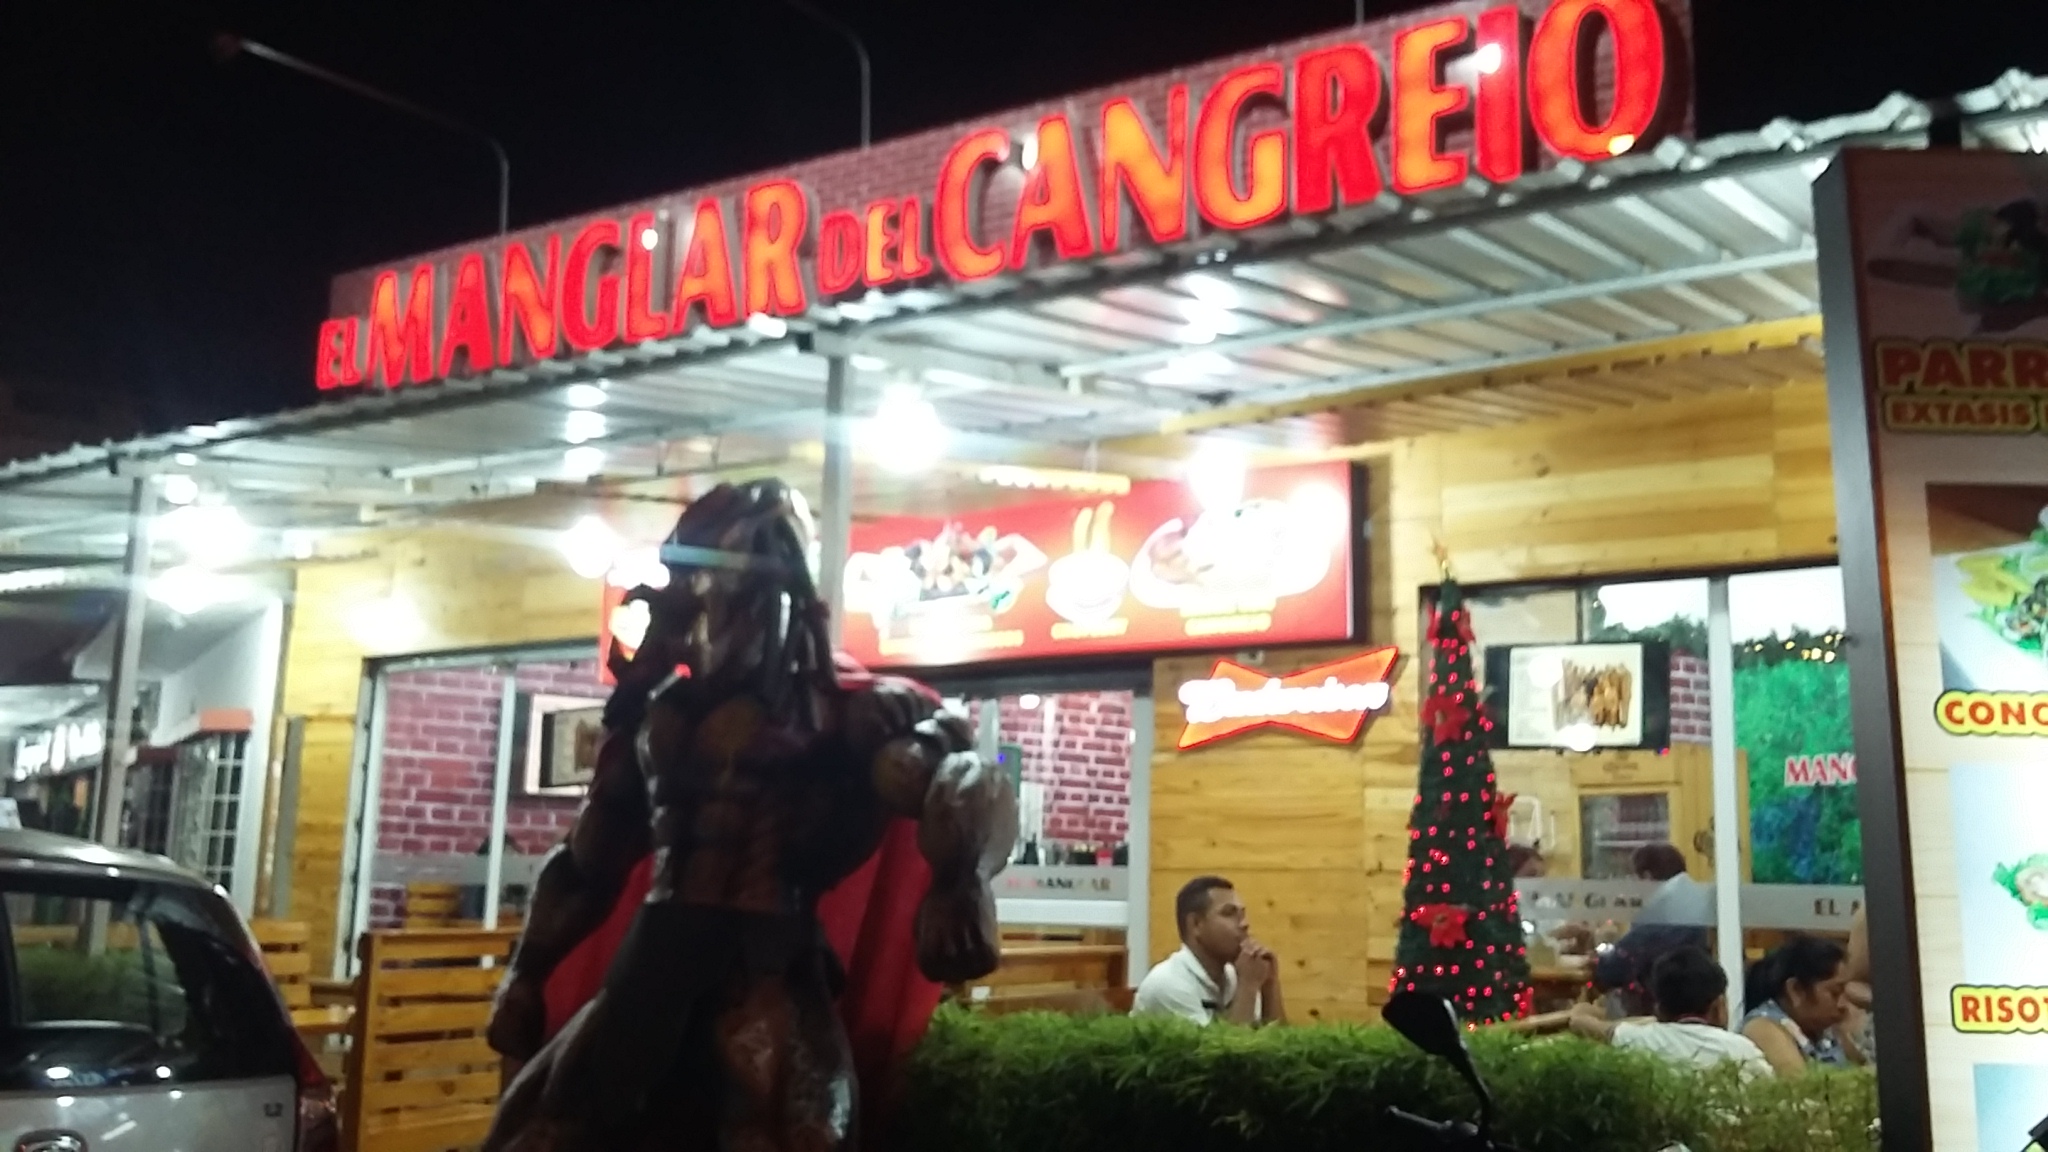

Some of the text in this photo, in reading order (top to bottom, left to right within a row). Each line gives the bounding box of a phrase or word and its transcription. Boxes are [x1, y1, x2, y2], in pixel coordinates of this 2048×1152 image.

[316, 317, 363, 390] EL
[367, 178, 807, 388] MANGLAR
[817, 195, 932, 294] DEL
[1890, 401, 2032, 426] EXTASIS
[1786, 754, 1857, 785] MAN
[1960, 995, 2048, 1023] RISO
